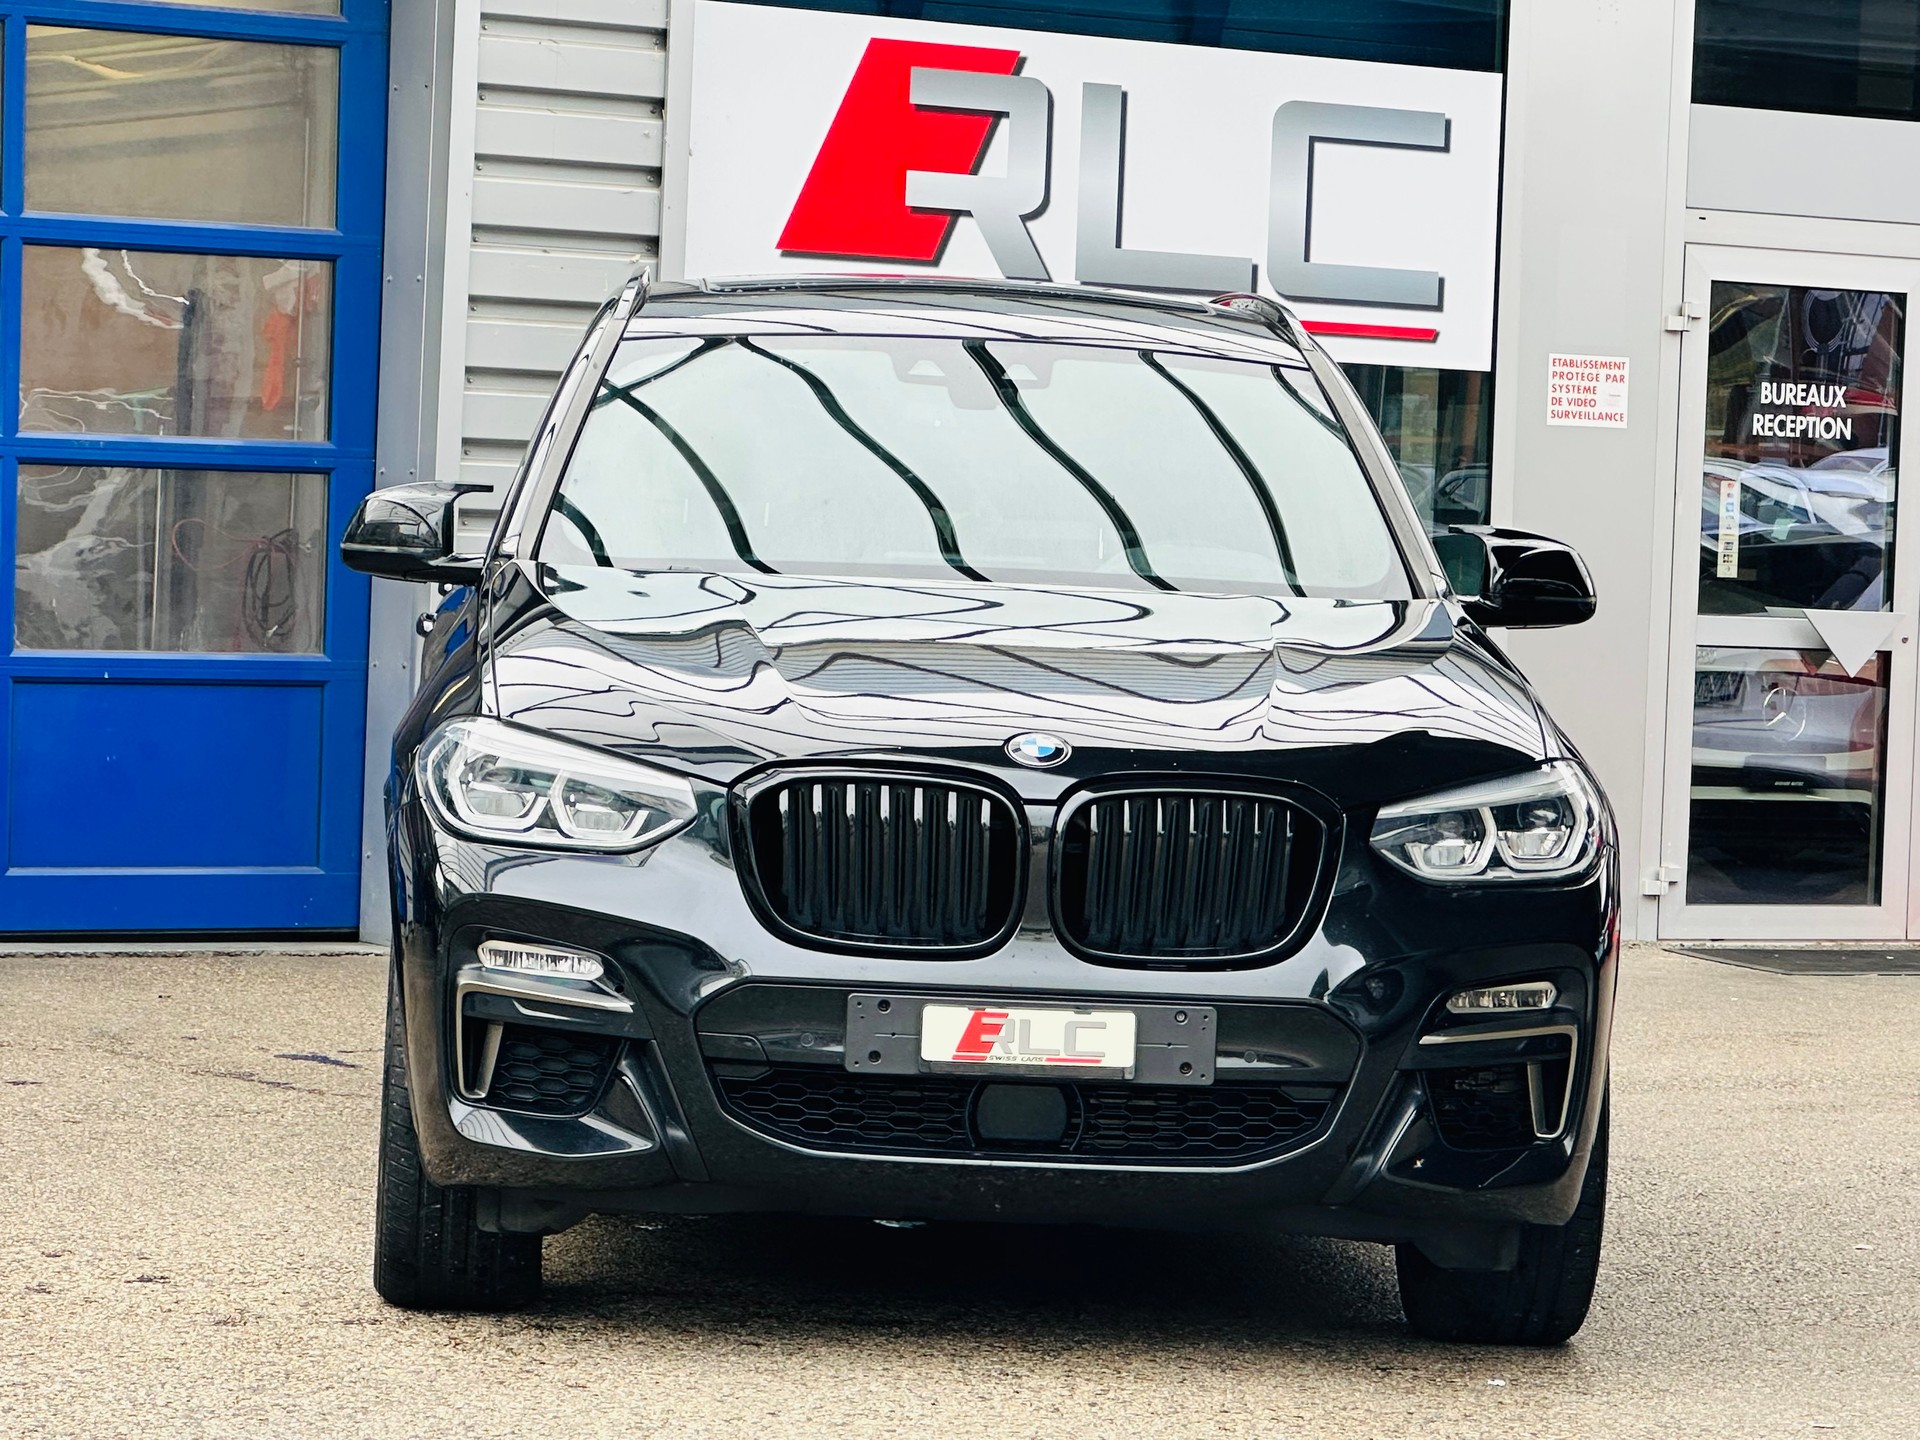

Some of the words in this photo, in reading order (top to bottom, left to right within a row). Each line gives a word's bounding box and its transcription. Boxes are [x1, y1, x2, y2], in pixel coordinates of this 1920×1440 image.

[1552, 357, 1626, 371] ETABLISSEMENT
[1605, 373, 1626, 384] PAR
[1551, 396, 1563, 406] DE
[1760, 381, 1847, 408] BUREAUX
[1550, 409, 1625, 423] SURVEILLANCE
[1752, 413, 1852, 440] RECEPTION
